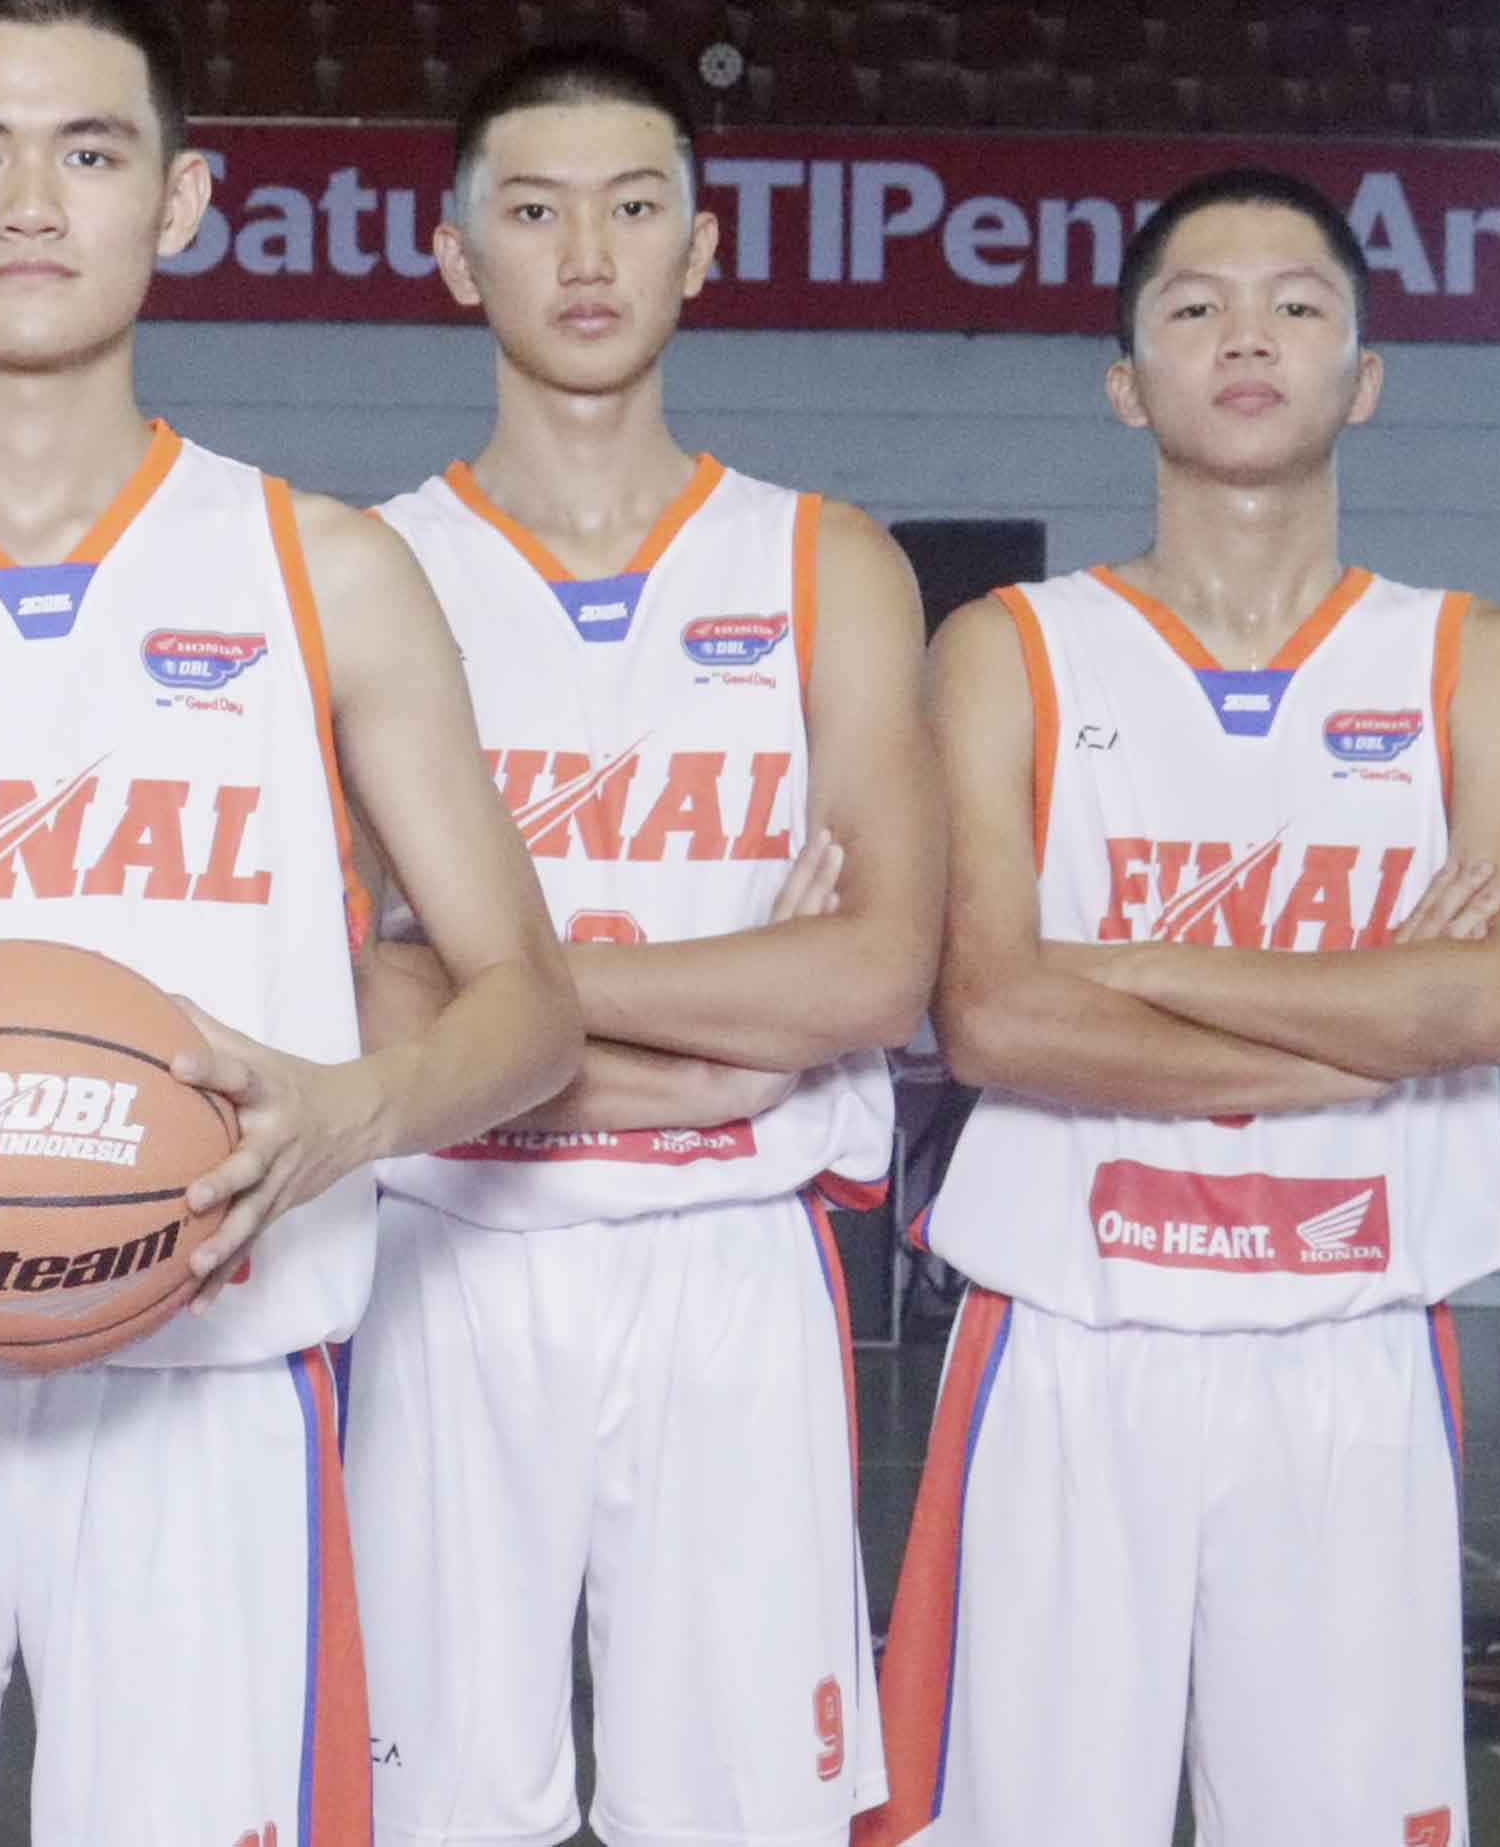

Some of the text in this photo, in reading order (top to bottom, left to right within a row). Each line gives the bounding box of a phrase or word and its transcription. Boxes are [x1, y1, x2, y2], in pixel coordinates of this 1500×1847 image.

[178, 660, 213, 679] DBL
[488, 742, 793, 862] INAL
[1097, 830, 1417, 950] FINAL
[1098, 1209, 1275, 1260] One HEART.
[1300, 1248, 1384, 1263] HONDA
[813, 1676, 846, 1784] 9
